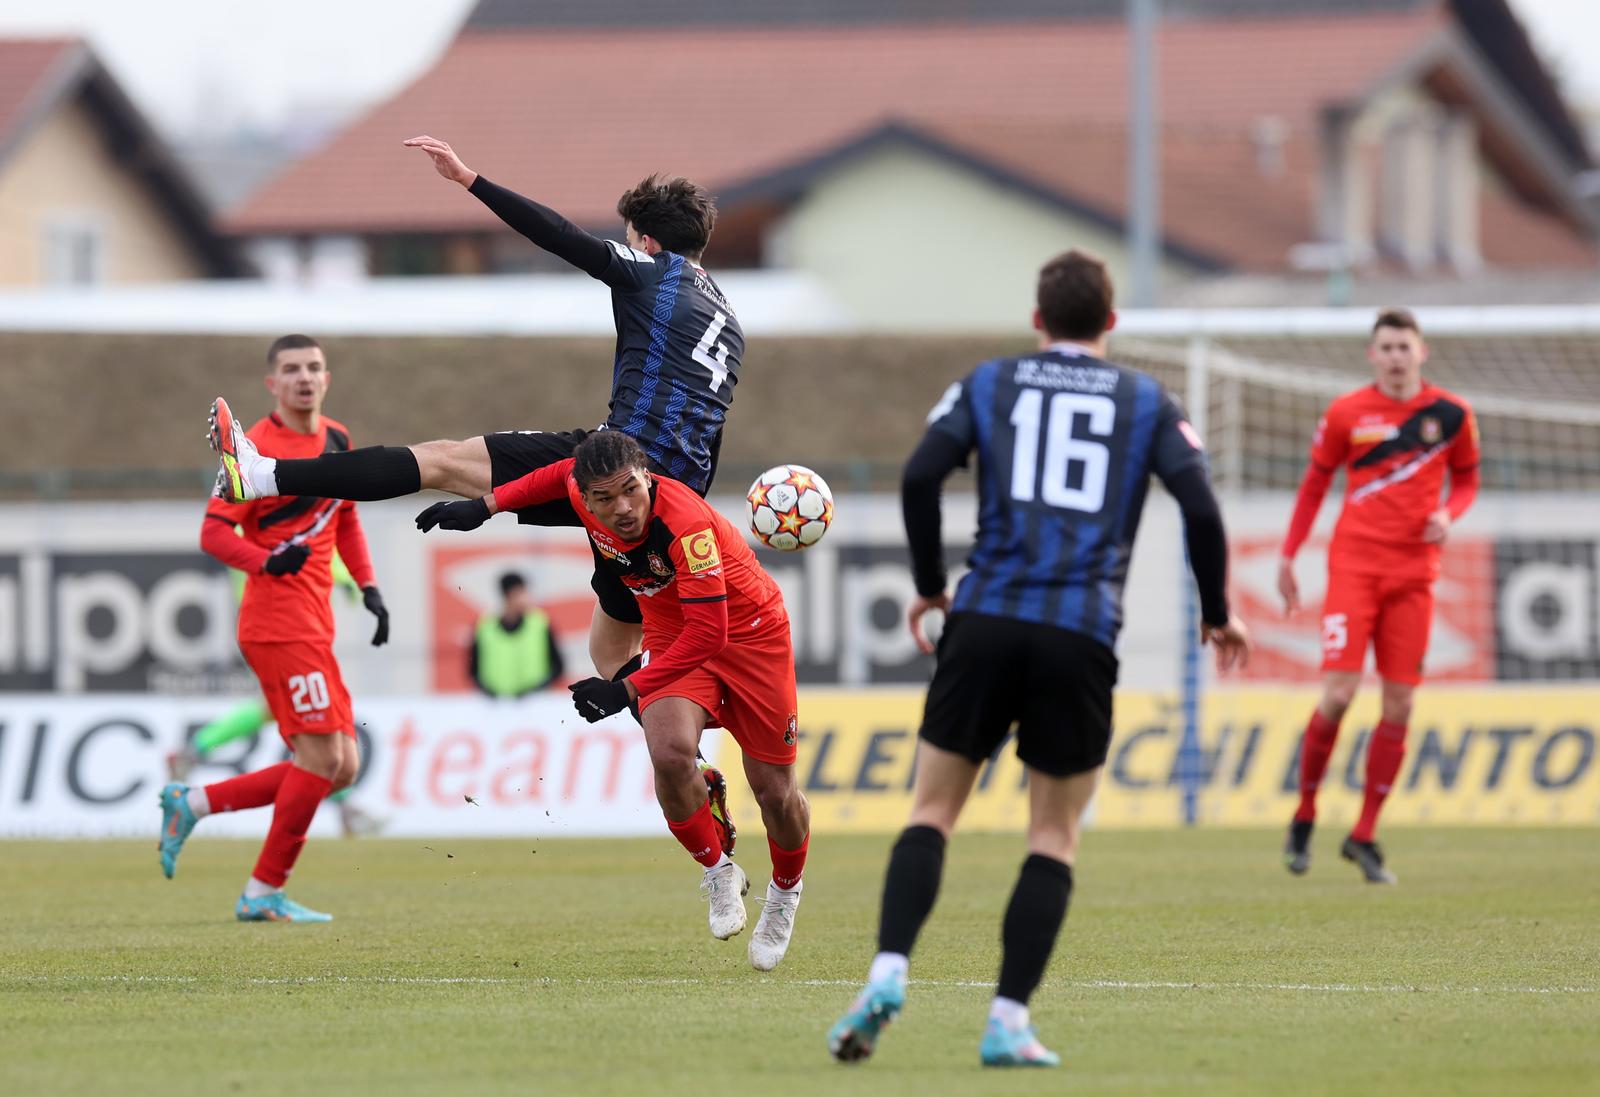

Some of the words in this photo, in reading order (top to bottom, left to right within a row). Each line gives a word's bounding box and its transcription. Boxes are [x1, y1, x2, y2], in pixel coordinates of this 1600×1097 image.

[692, 311, 730, 393] 4
[1009, 388, 1116, 514] 16
[288, 671, 331, 713] 20
